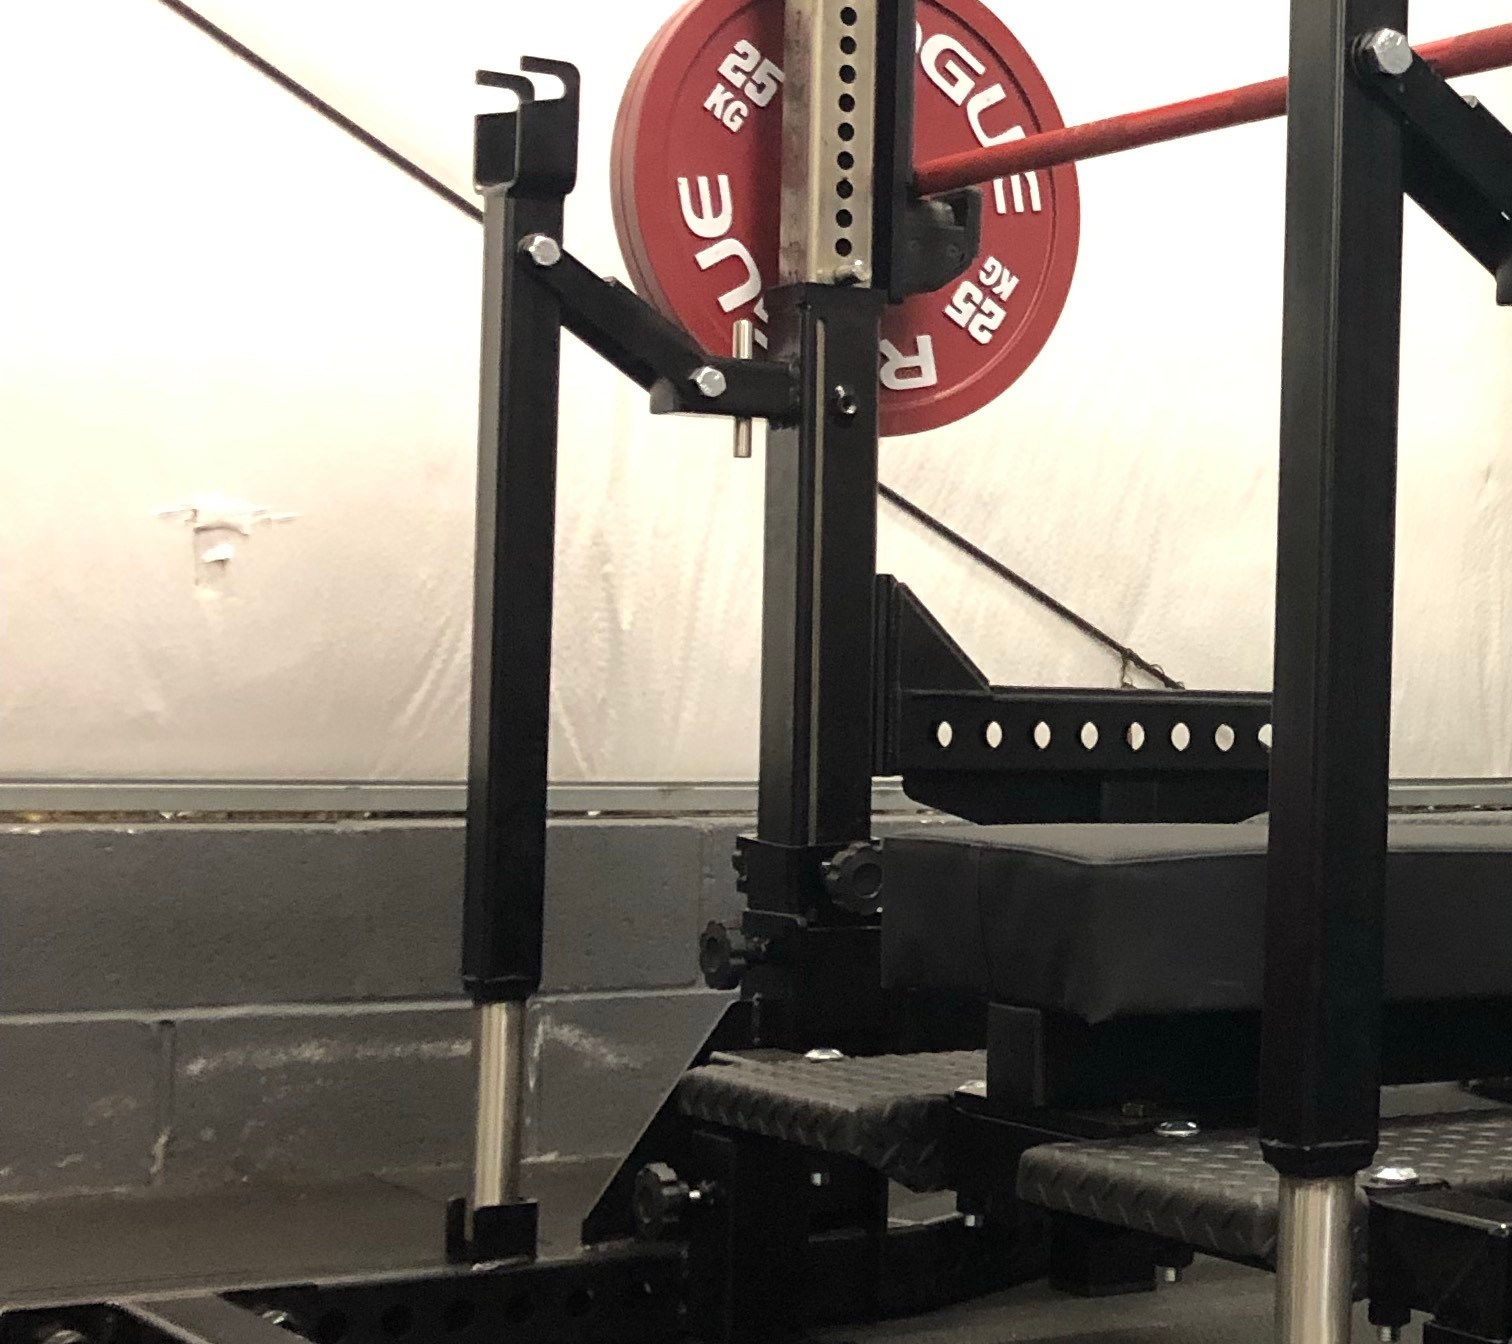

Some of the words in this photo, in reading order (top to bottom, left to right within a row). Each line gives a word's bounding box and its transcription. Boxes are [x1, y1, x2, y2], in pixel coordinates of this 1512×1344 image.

[717, 39, 785, 108] 25
[703, 82, 749, 133] KG
[979, 255, 1021, 302] KG
[943, 279, 1008, 345] 25
